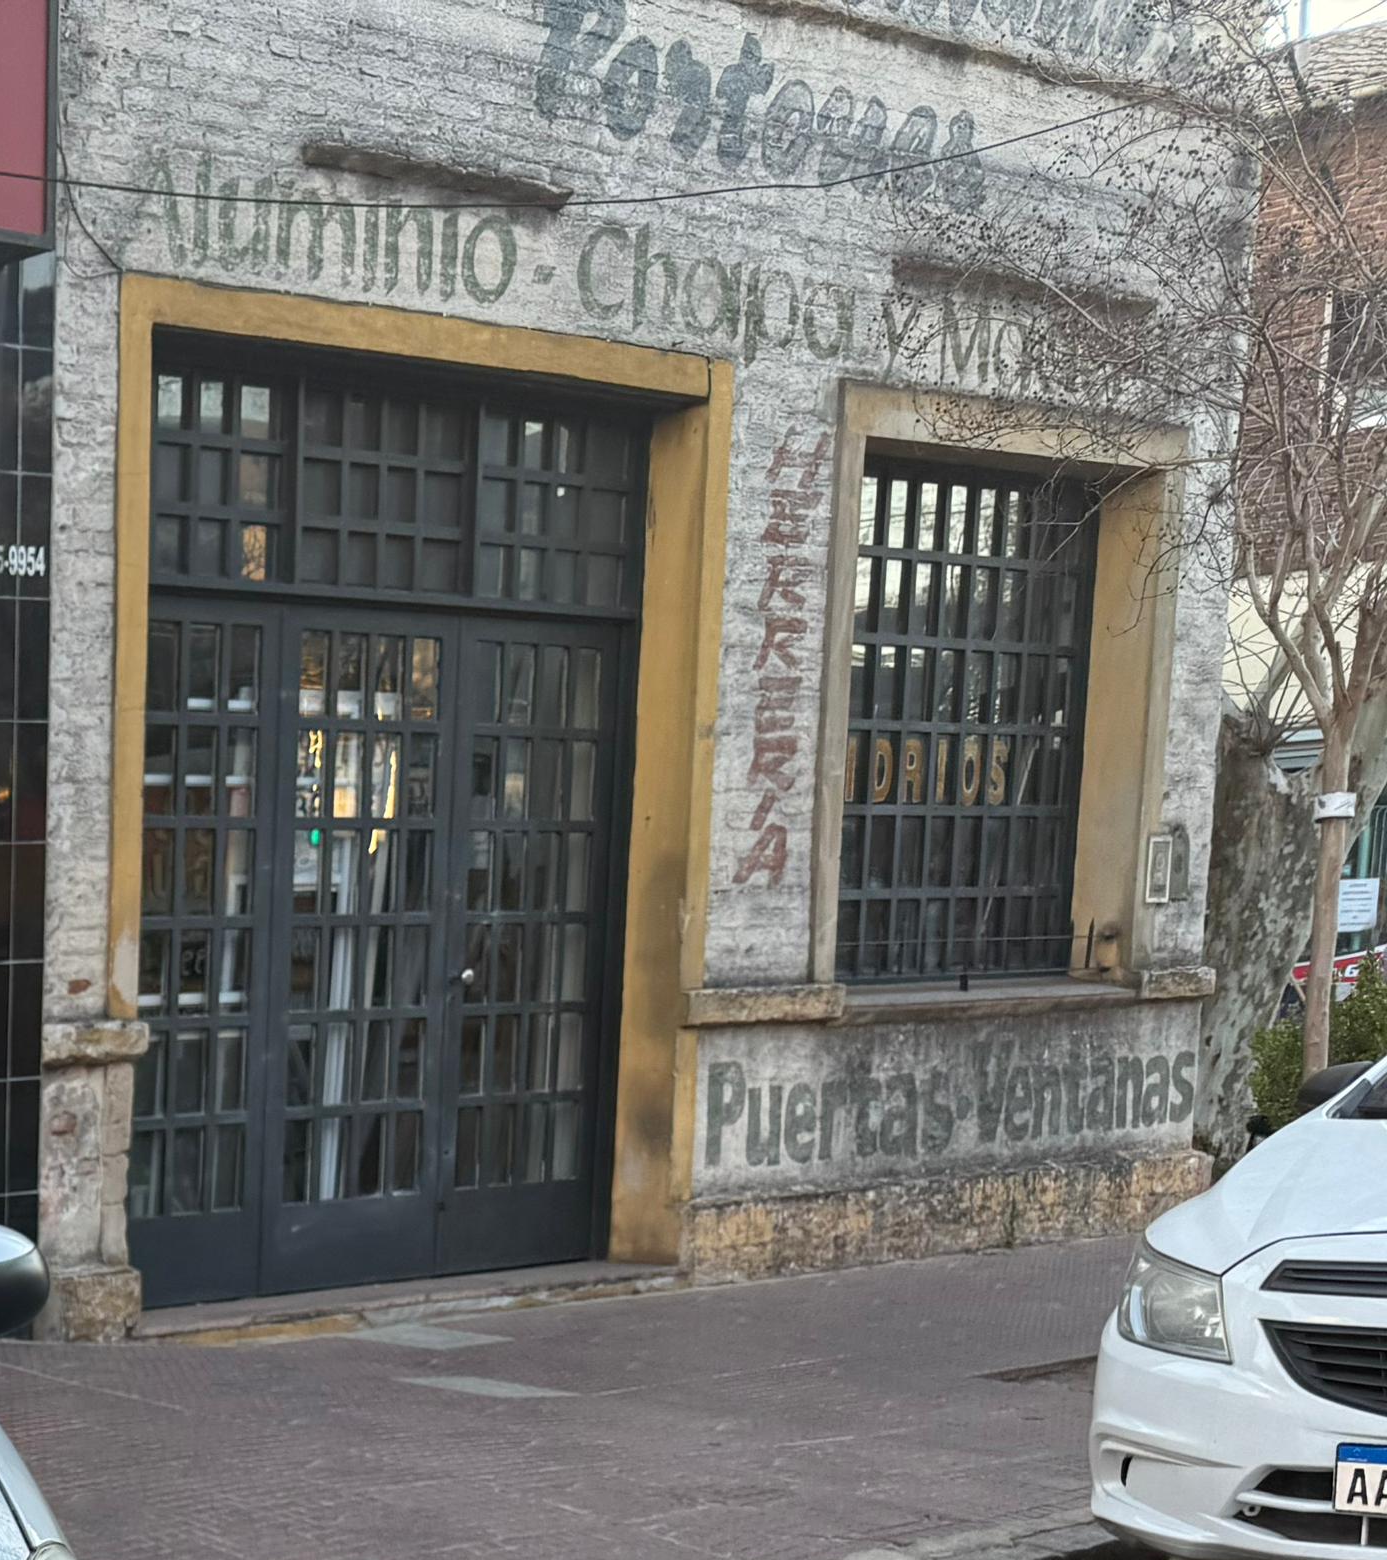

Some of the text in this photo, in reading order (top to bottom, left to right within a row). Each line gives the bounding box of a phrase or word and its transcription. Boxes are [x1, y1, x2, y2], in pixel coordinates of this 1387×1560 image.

[139, 148, 518, 304] Aluminio
[577, 222, 859, 366] Chapa
[731, 424, 829, 886] HERRERIA
[845, 735, 1010, 806] IDRIOS
[705, 1039, 1197, 1167] Puertas Ventanas
